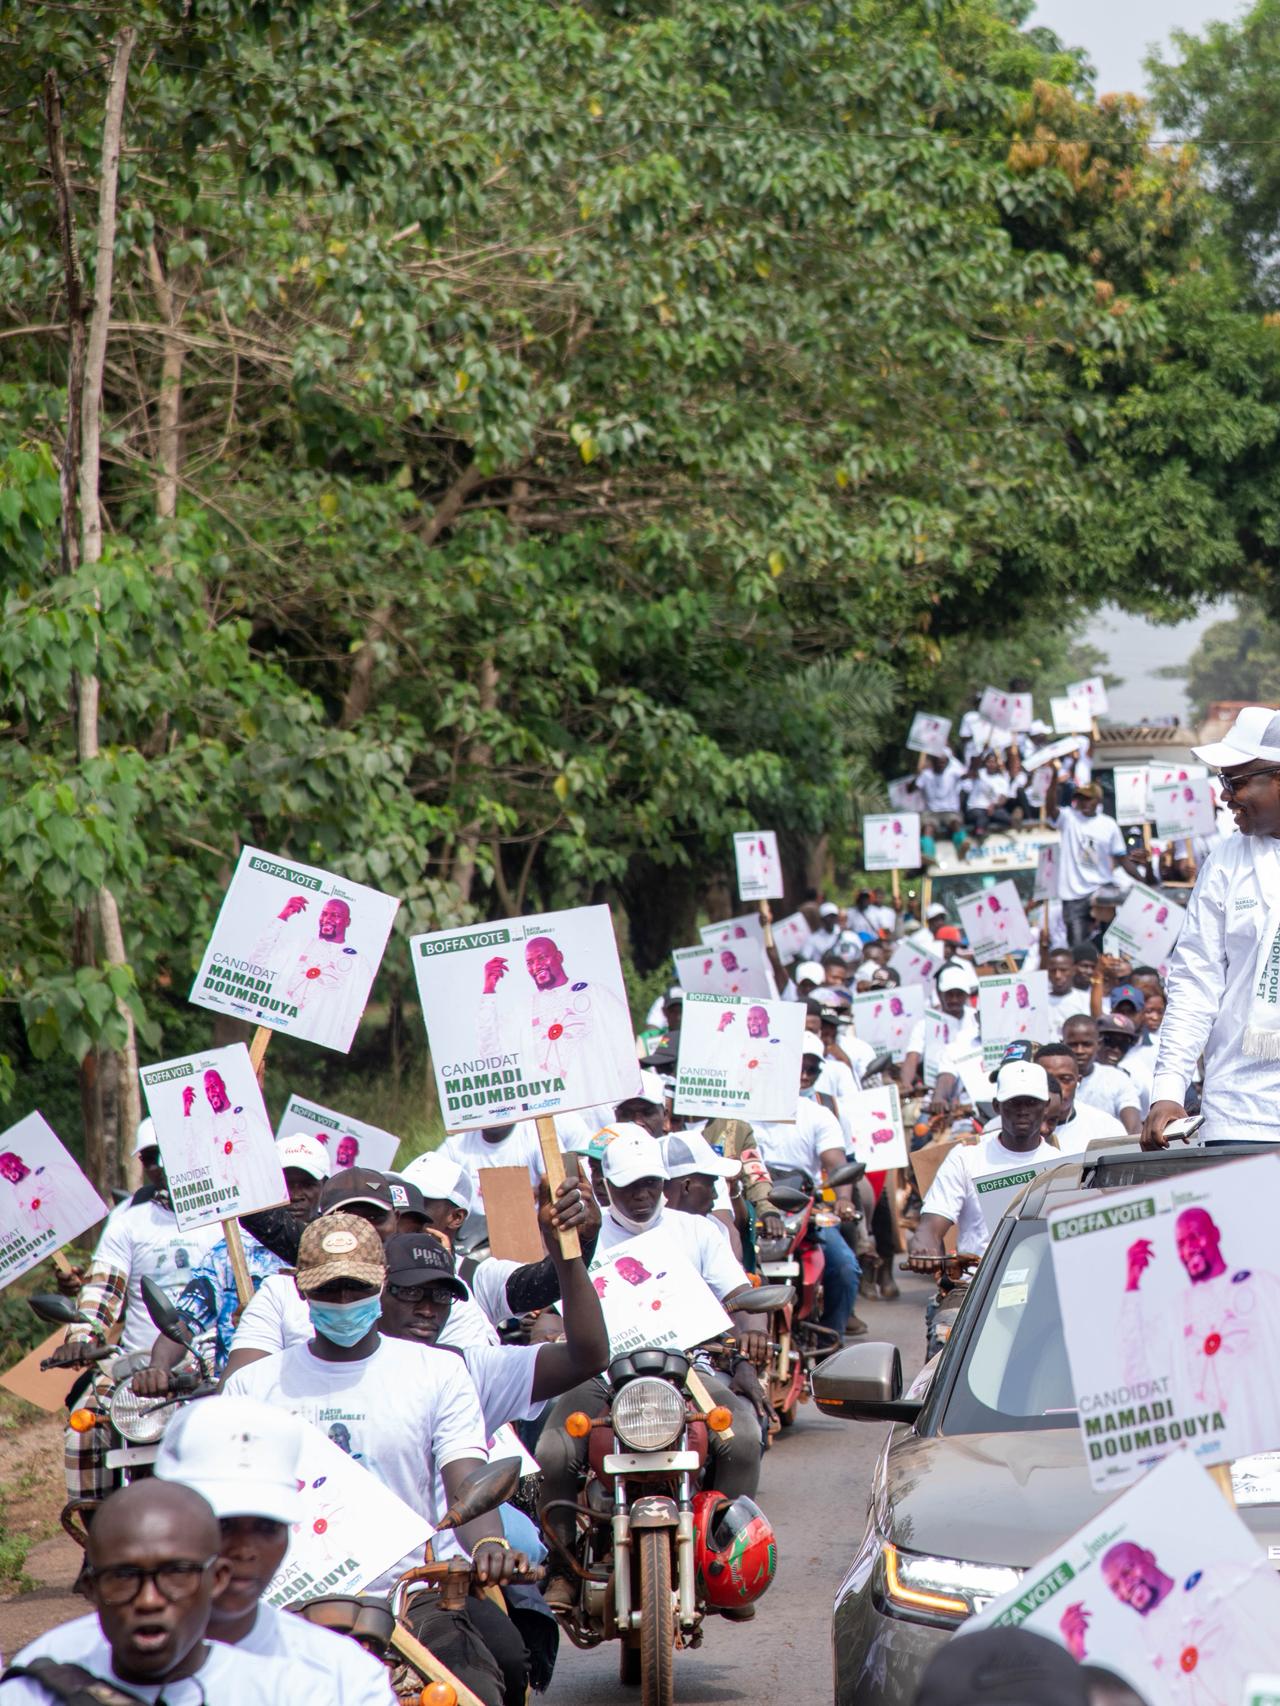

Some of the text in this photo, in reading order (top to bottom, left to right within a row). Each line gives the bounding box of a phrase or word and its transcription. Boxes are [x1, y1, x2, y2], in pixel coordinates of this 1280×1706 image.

[253, 859, 318, 889] BOFFA VOTE
[426, 938, 468, 955] BOFFA
[471, 932, 504, 946] VOTE
[208, 964, 273, 994] MAMADI
[212, 952, 278, 981] CANDIDAT
[203, 977, 299, 1018] DOUMBOUYA
[689, 993, 738, 1004] BOFFA VOTE
[1268, 969, 1279, 1003] POUR
[147, 1065, 192, 1085] BOFFA VOTE
[442, 1052, 519, 1077] CANDIDAT
[680, 1066, 728, 1078] CANDIDAT
[445, 1068, 522, 1094] MAMADI
[447, 1077, 566, 1111] DOUMBOUYA
[678, 1087, 751, 1100] DOUMBOUYA
[680, 1076, 727, 1088] MAMADI
[293, 1105, 337, 1130] BOFFA VOTE
[170, 1165, 211, 1186] CANDIDAT
[980, 1173, 1032, 1192] BOFFA VOTE
[172, 1178, 214, 1200] MAMADI
[176, 1185, 240, 1214] DOUMBOUYA
[1057, 1201, 1149, 1240] BOFFA VOTE
[0, 1236, 26, 1259] MADI
[0, 1229, 56, 1273] UMBOUYA
[610, 1325, 639, 1345] DIDAT
[613, 1333, 647, 1355] MADI
[1080, 1376, 1169, 1413] CANDIDAT
[1085, 1398, 1174, 1437] MAMADI
[1089, 1411, 1226, 1461] DOUMBOUYA
[267, 1572, 314, 1608] MADI
[1022, 1567, 1070, 1610] VOTE
